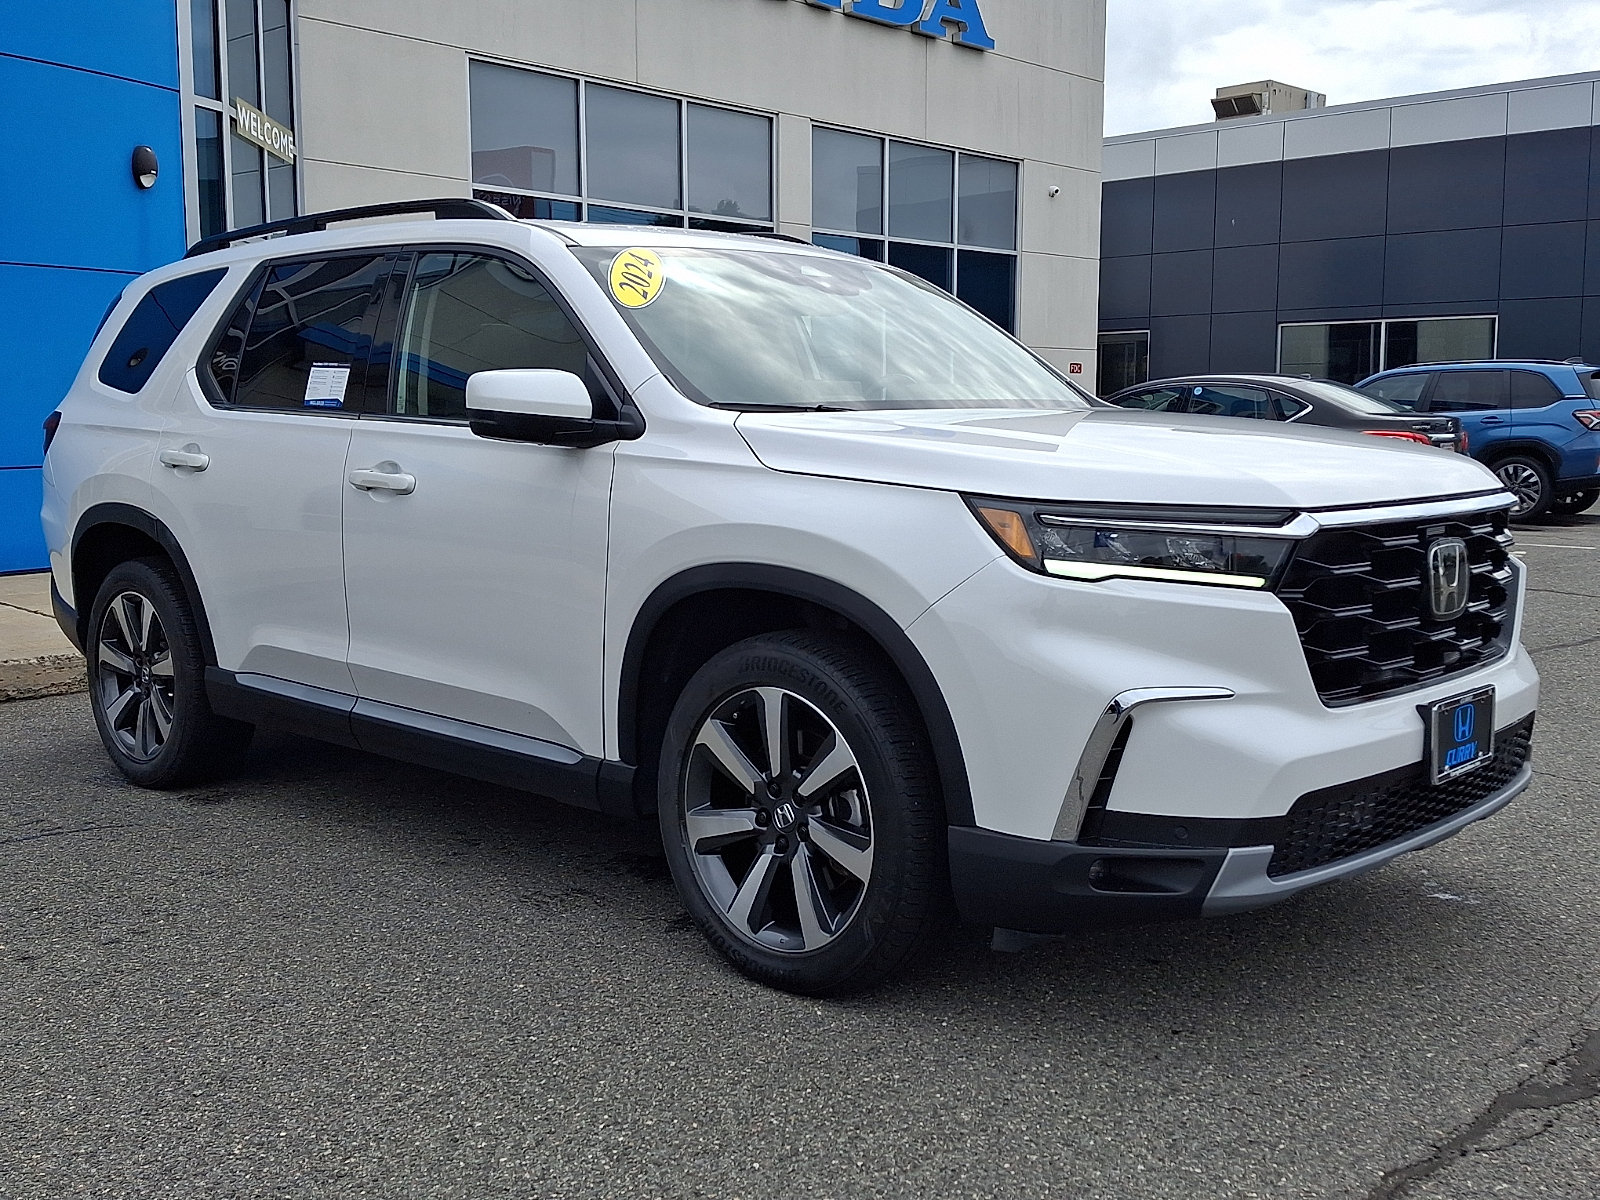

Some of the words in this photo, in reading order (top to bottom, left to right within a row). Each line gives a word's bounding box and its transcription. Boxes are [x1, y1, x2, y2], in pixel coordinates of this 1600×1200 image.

[236, 103, 294, 159] WELCOME
[619, 252, 654, 300] 2024
[1070, 364, 1081, 373] FDC
[738, 655, 848, 715] BRIDGESTONE
[1446, 740, 1478, 766] CURRY
